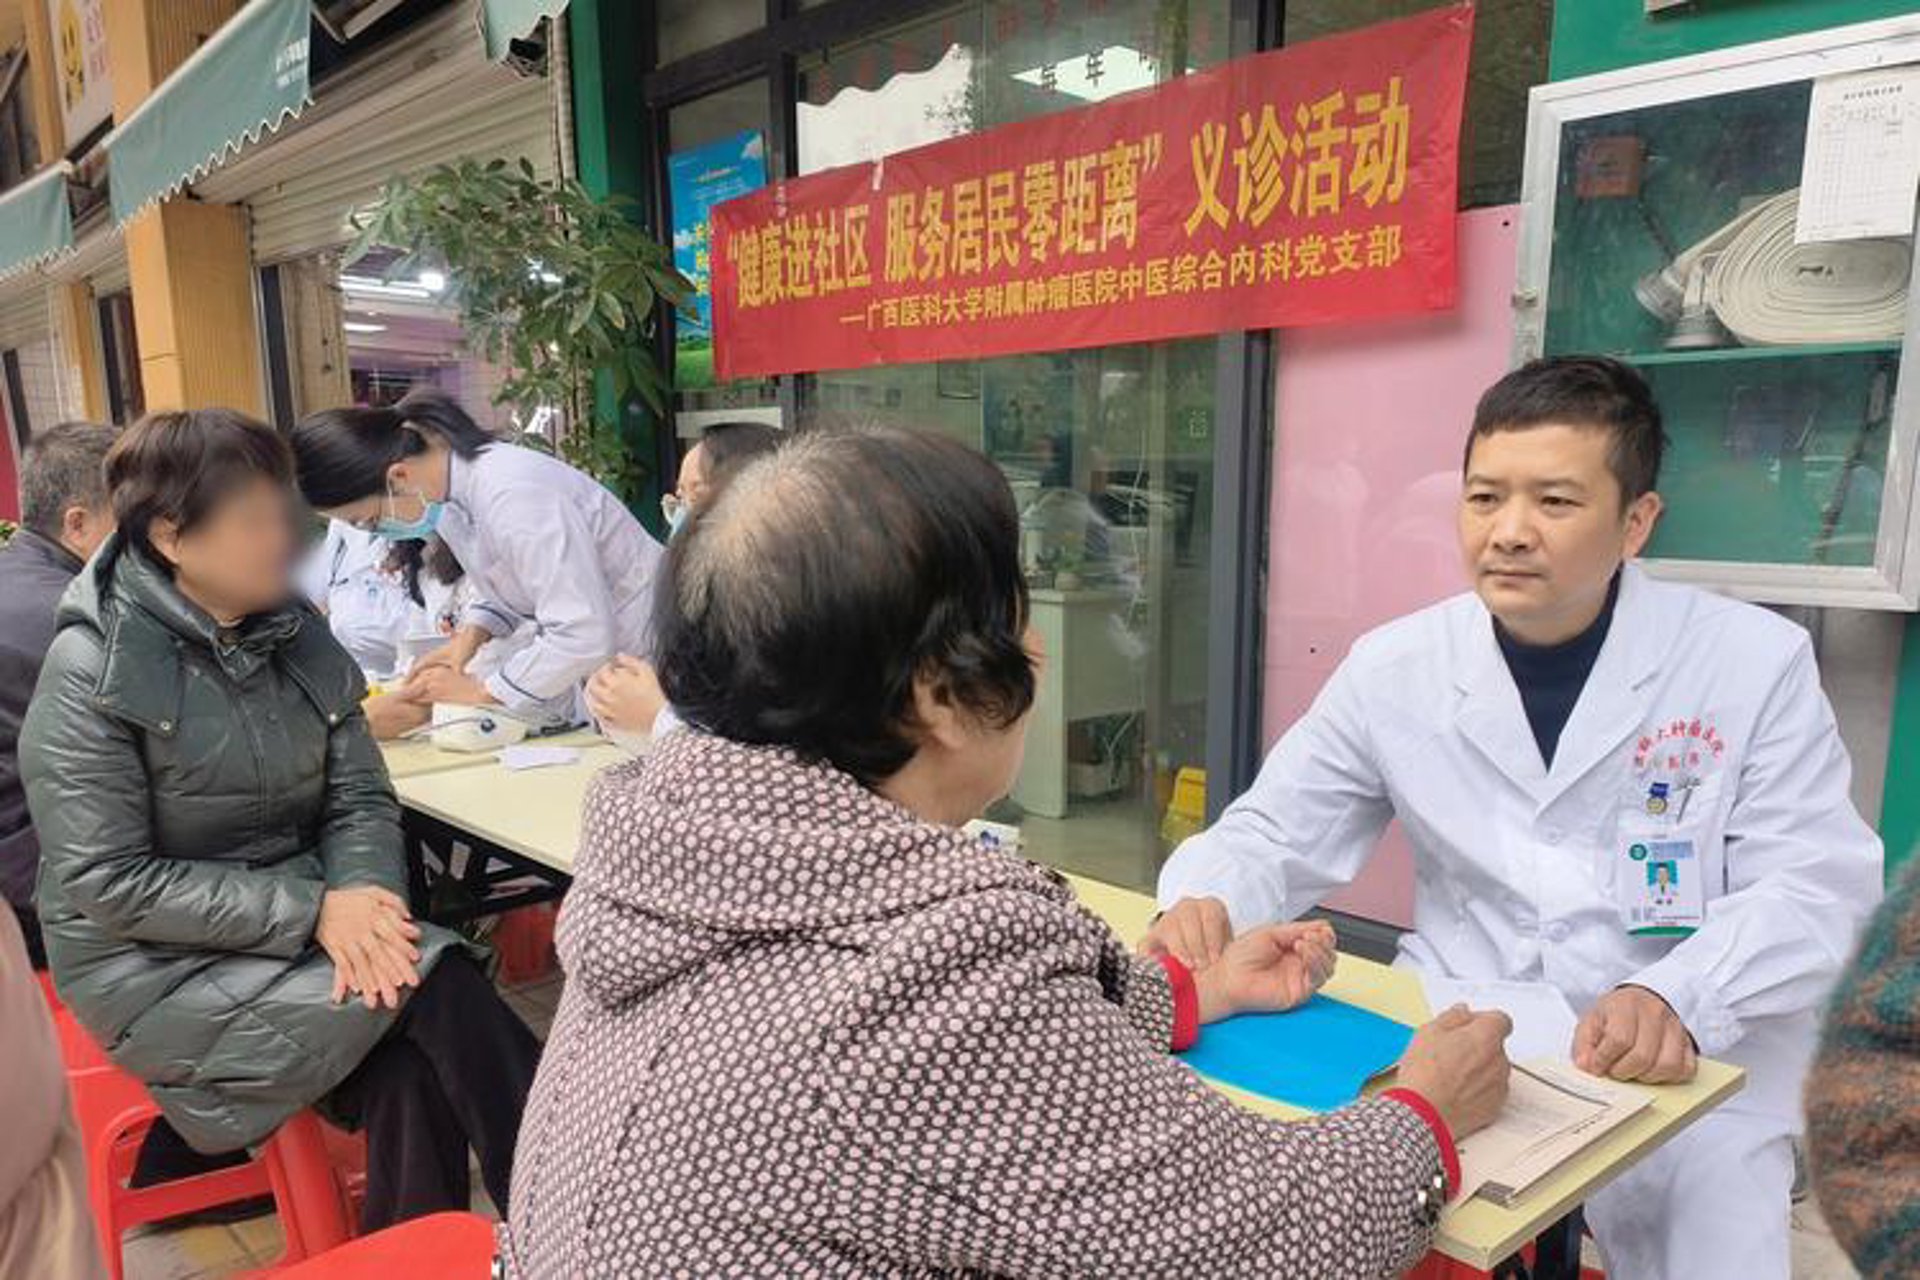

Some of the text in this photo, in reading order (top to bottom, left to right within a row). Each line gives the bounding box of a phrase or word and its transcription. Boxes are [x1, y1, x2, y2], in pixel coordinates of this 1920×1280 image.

[727, 203, 873, 308] “健康进社区
[885, 132, 1163, 283] 服务居民零距离”
[1184, 76, 1410, 238] 义诊活动
